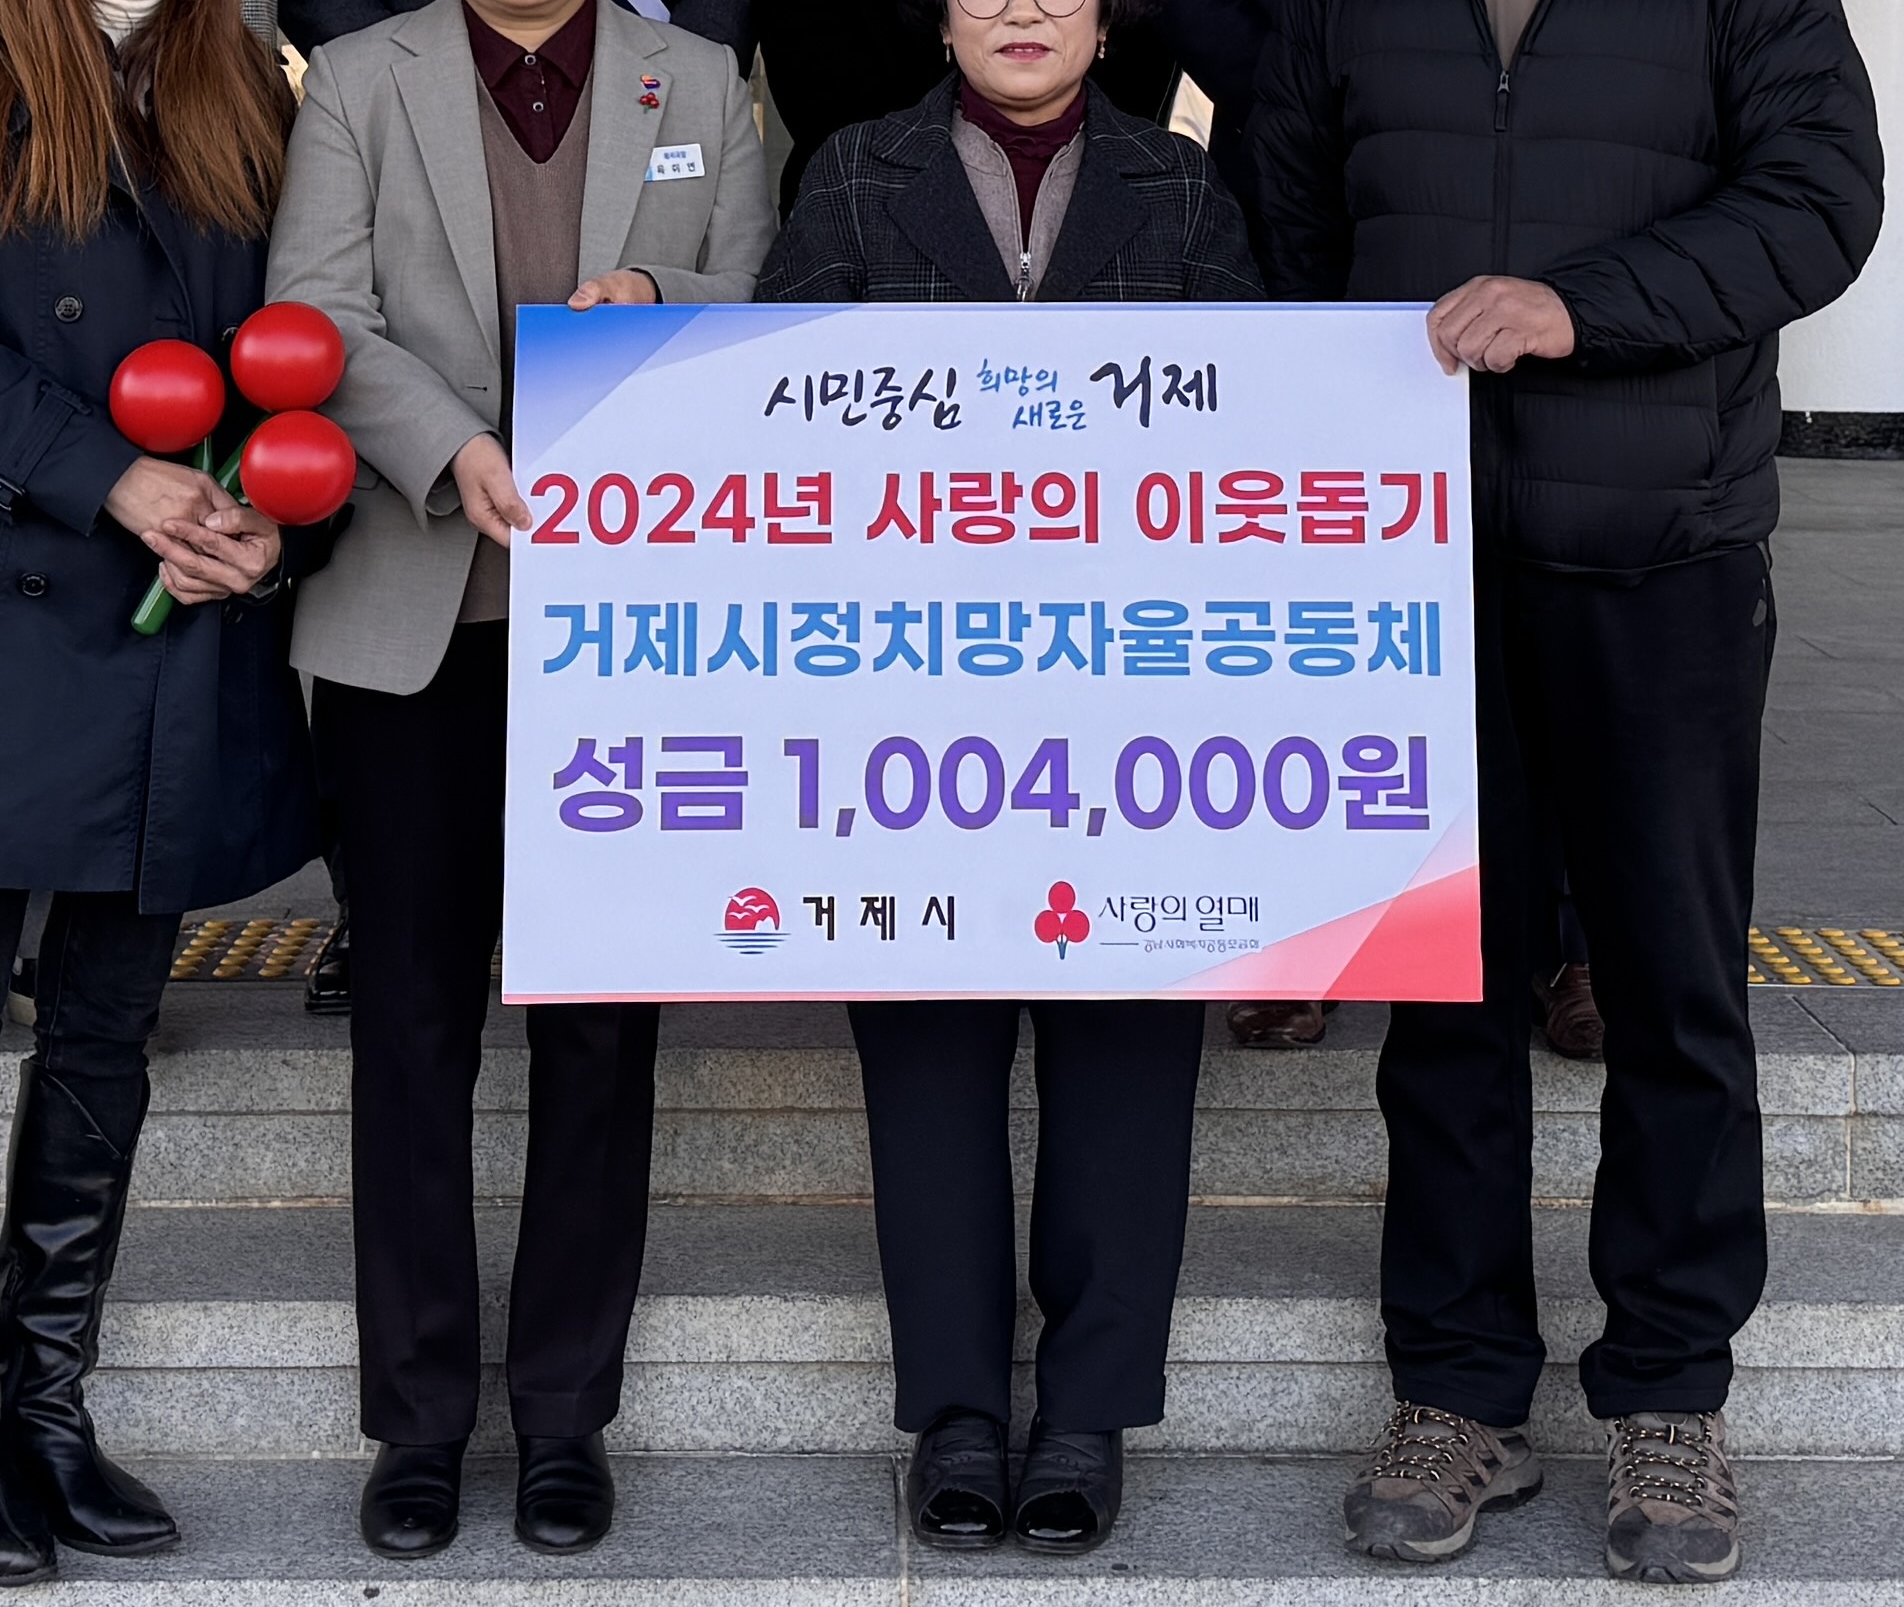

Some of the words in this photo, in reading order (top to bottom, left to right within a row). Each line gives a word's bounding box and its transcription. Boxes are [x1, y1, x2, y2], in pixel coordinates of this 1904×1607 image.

[762, 365, 963, 432] 시민중심
[976, 357, 1059, 395] 희망의
[1089, 355, 1218, 429] 거제
[1011, 397, 1088, 432] 새로운
[529, 471, 834, 546] 2024년
[865, 470, 1100, 546] 사랑의
[1134, 469, 1450, 546] 이웃돕기
[541, 599, 1442, 678] 거제시정치망자율공동체
[551, 734, 750, 834] 성금
[782, 733, 1432, 839] 1,004,000원
[801, 894, 957, 943] 거제시
[1098, 895, 1187, 933] 사랑의
[1195, 895, 1259, 932] 열매
